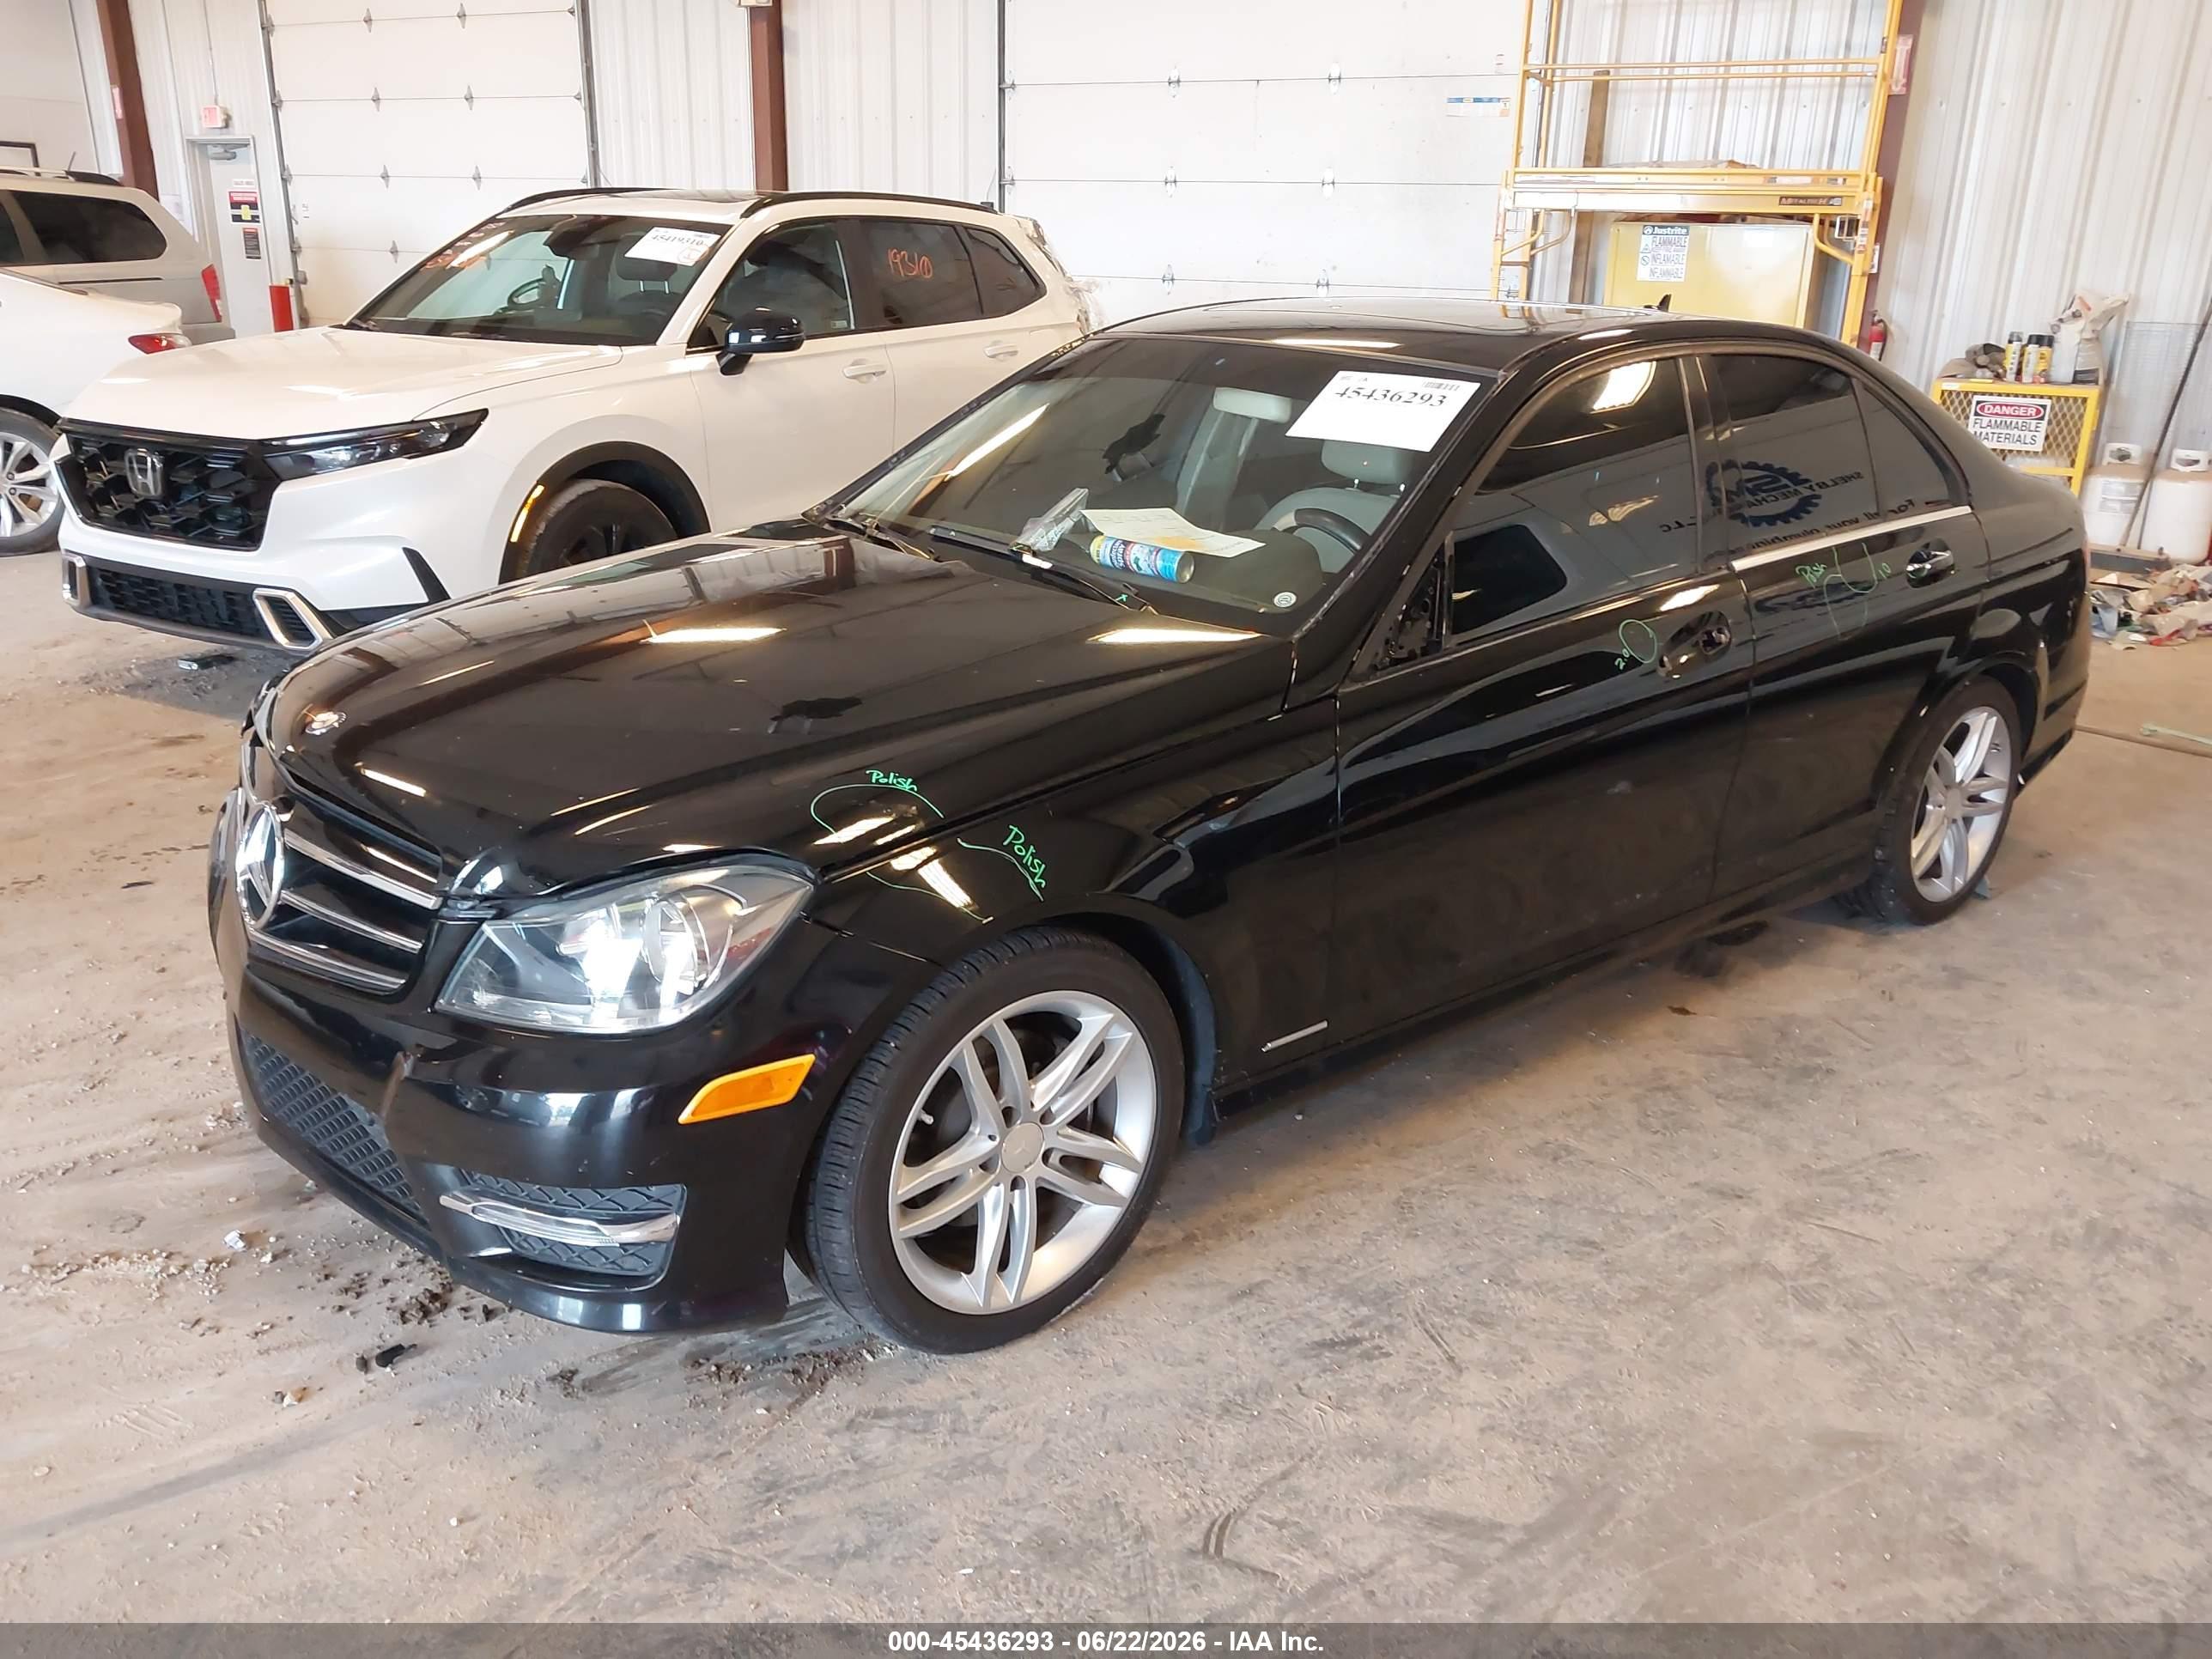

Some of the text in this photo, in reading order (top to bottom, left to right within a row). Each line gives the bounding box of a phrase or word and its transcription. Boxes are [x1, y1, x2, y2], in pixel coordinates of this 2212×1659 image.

[1653, 226, 1687, 234] Justrite
[1335, 386, 1447, 407] 45436293
[1984, 404, 2037, 416] DANGER
[1973, 418, 2042, 433] FLAMMABLE
[1974, 431, 2038, 445] MATERIALS
[866, 769, 918, 792] Polish
[1003, 824, 1046, 888] Polish
